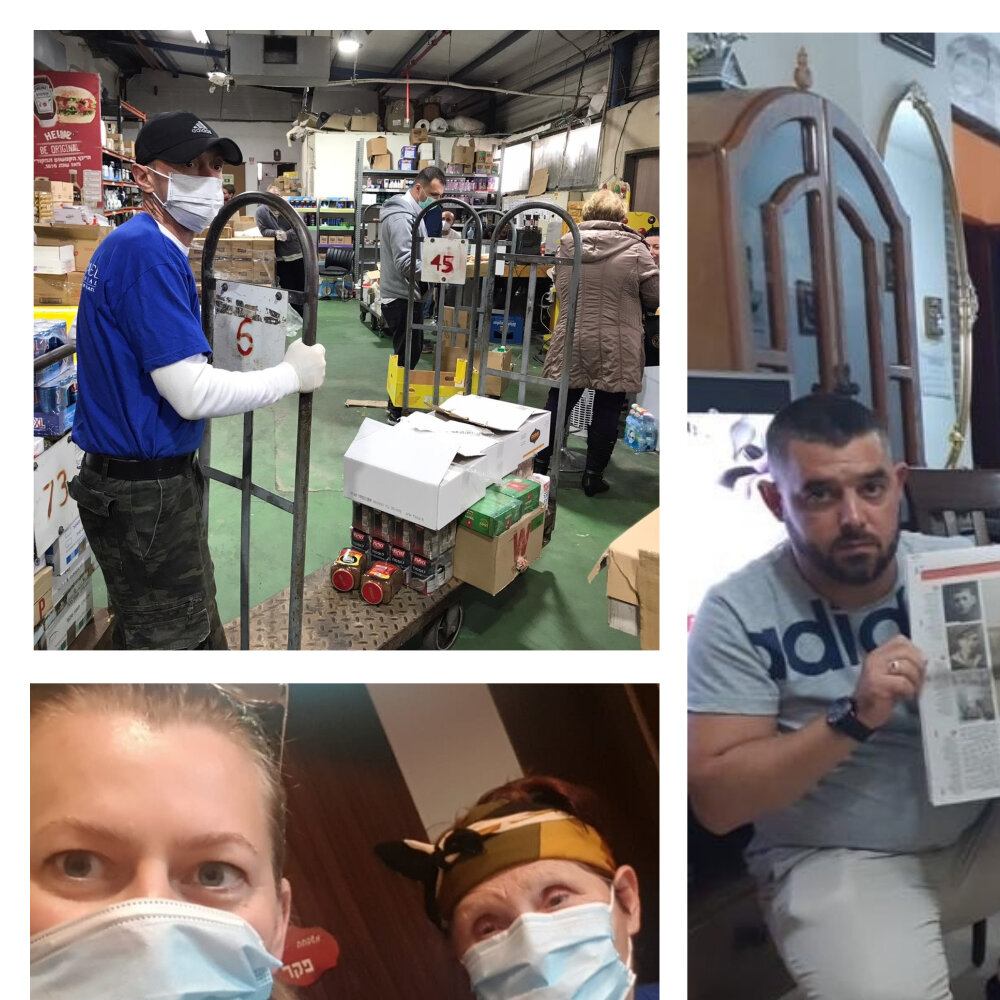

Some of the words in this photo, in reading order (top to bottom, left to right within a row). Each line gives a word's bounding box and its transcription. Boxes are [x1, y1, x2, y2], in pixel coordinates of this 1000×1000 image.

[39, 146, 49, 155] BE
[51, 144, 80, 154] ORIGINAL
[430, 254, 455, 274] 45
[236, 316, 254, 357] 6
[43, 469, 69, 521] 73
